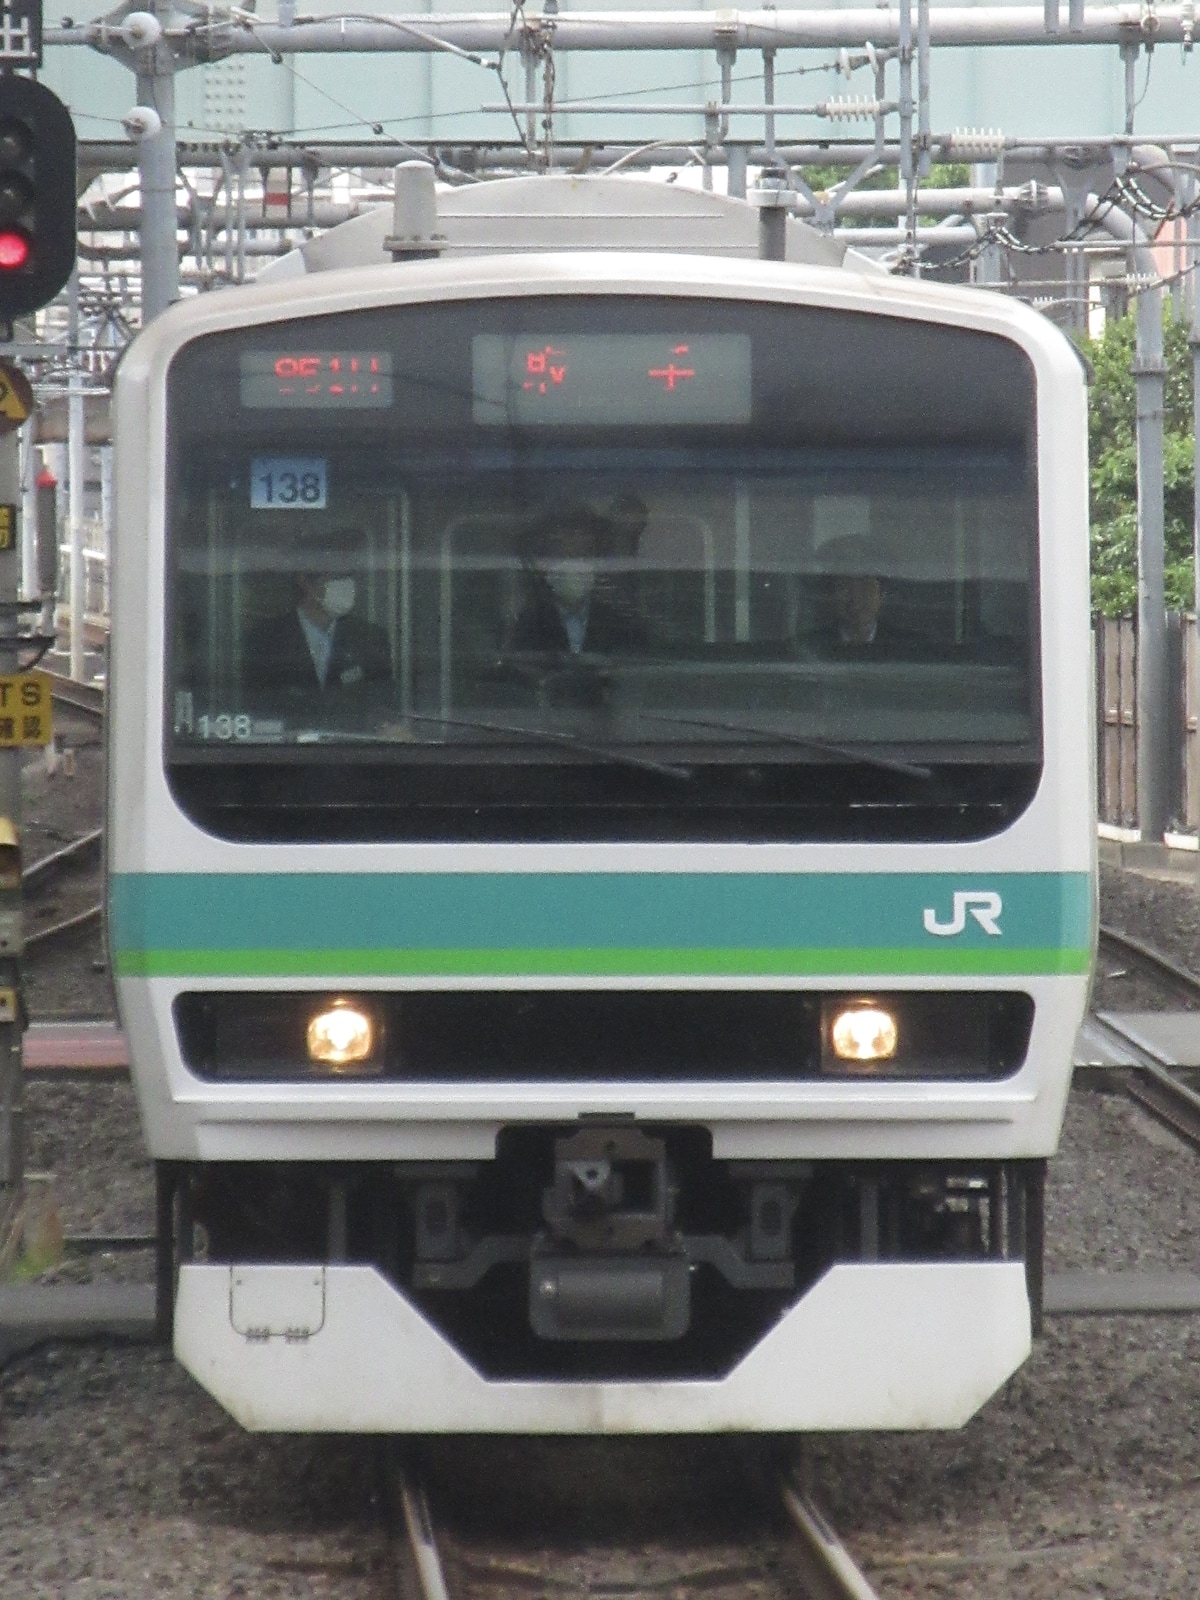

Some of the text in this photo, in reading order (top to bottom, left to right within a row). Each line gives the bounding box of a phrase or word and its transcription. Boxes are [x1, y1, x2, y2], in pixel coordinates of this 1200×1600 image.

[260, 472, 321, 503] 138
[200, 714, 251, 740] 138
[923, 891, 1003, 936] JR
